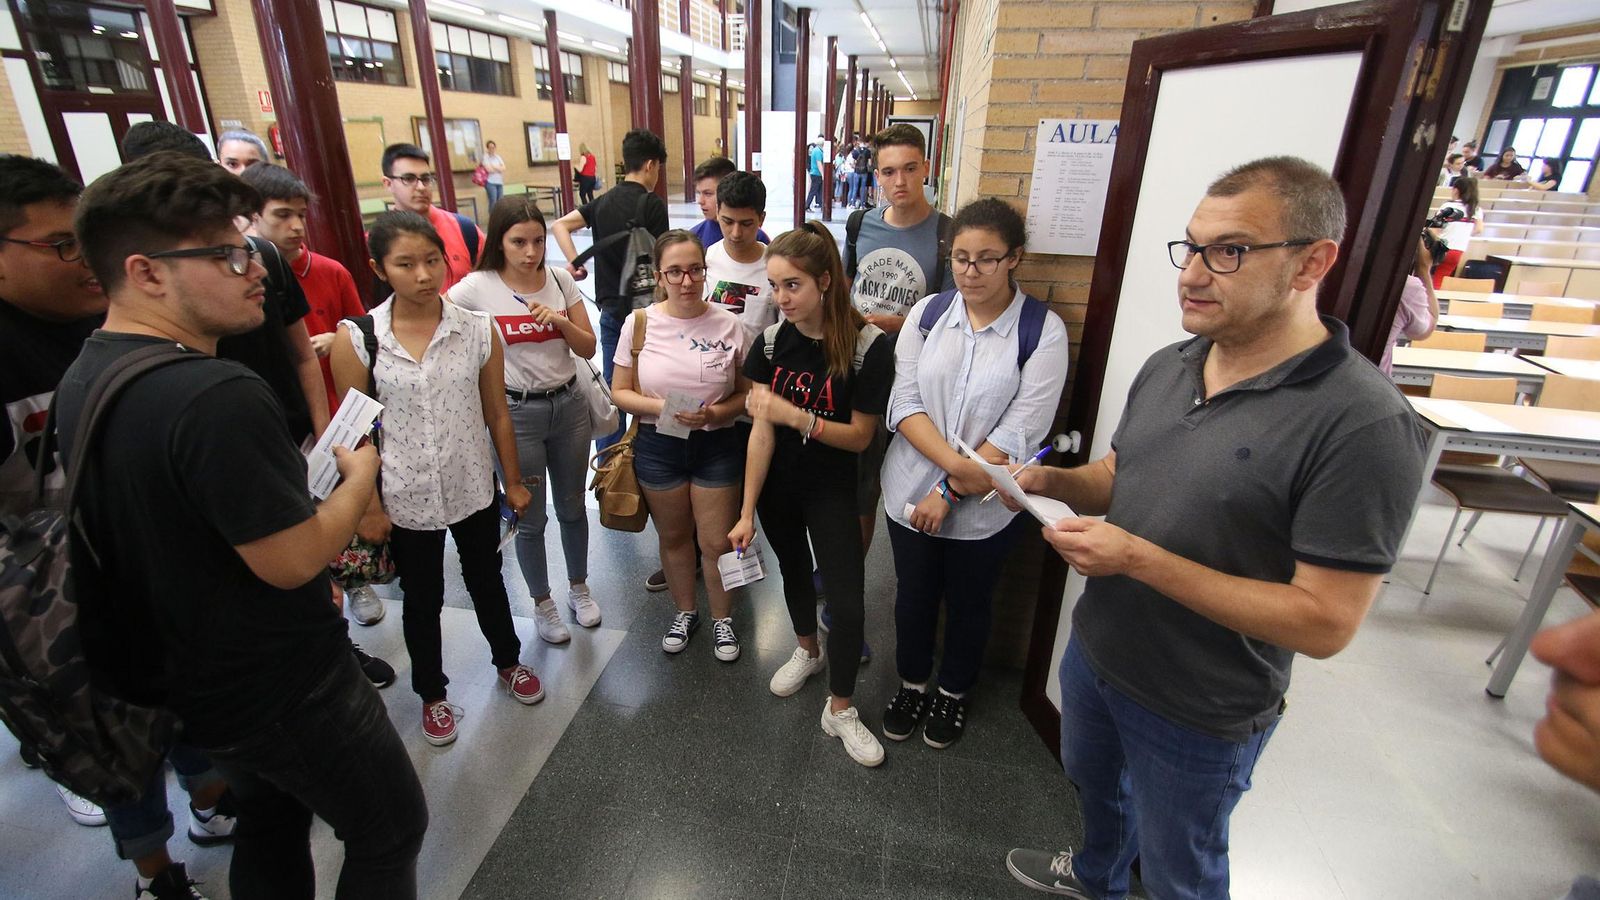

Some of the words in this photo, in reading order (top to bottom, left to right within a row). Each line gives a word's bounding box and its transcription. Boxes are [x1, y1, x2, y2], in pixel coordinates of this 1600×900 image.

[1049, 123, 1120, 143] AULA
[863, 257, 892, 277] TRADE
[895, 260, 917, 284] MARK
[881, 271, 899, 280] 1990
[880, 282, 888, 299] &
[886, 285, 919, 307] JONES
[505, 322, 553, 335] Levi
[771, 366, 835, 410] USA
